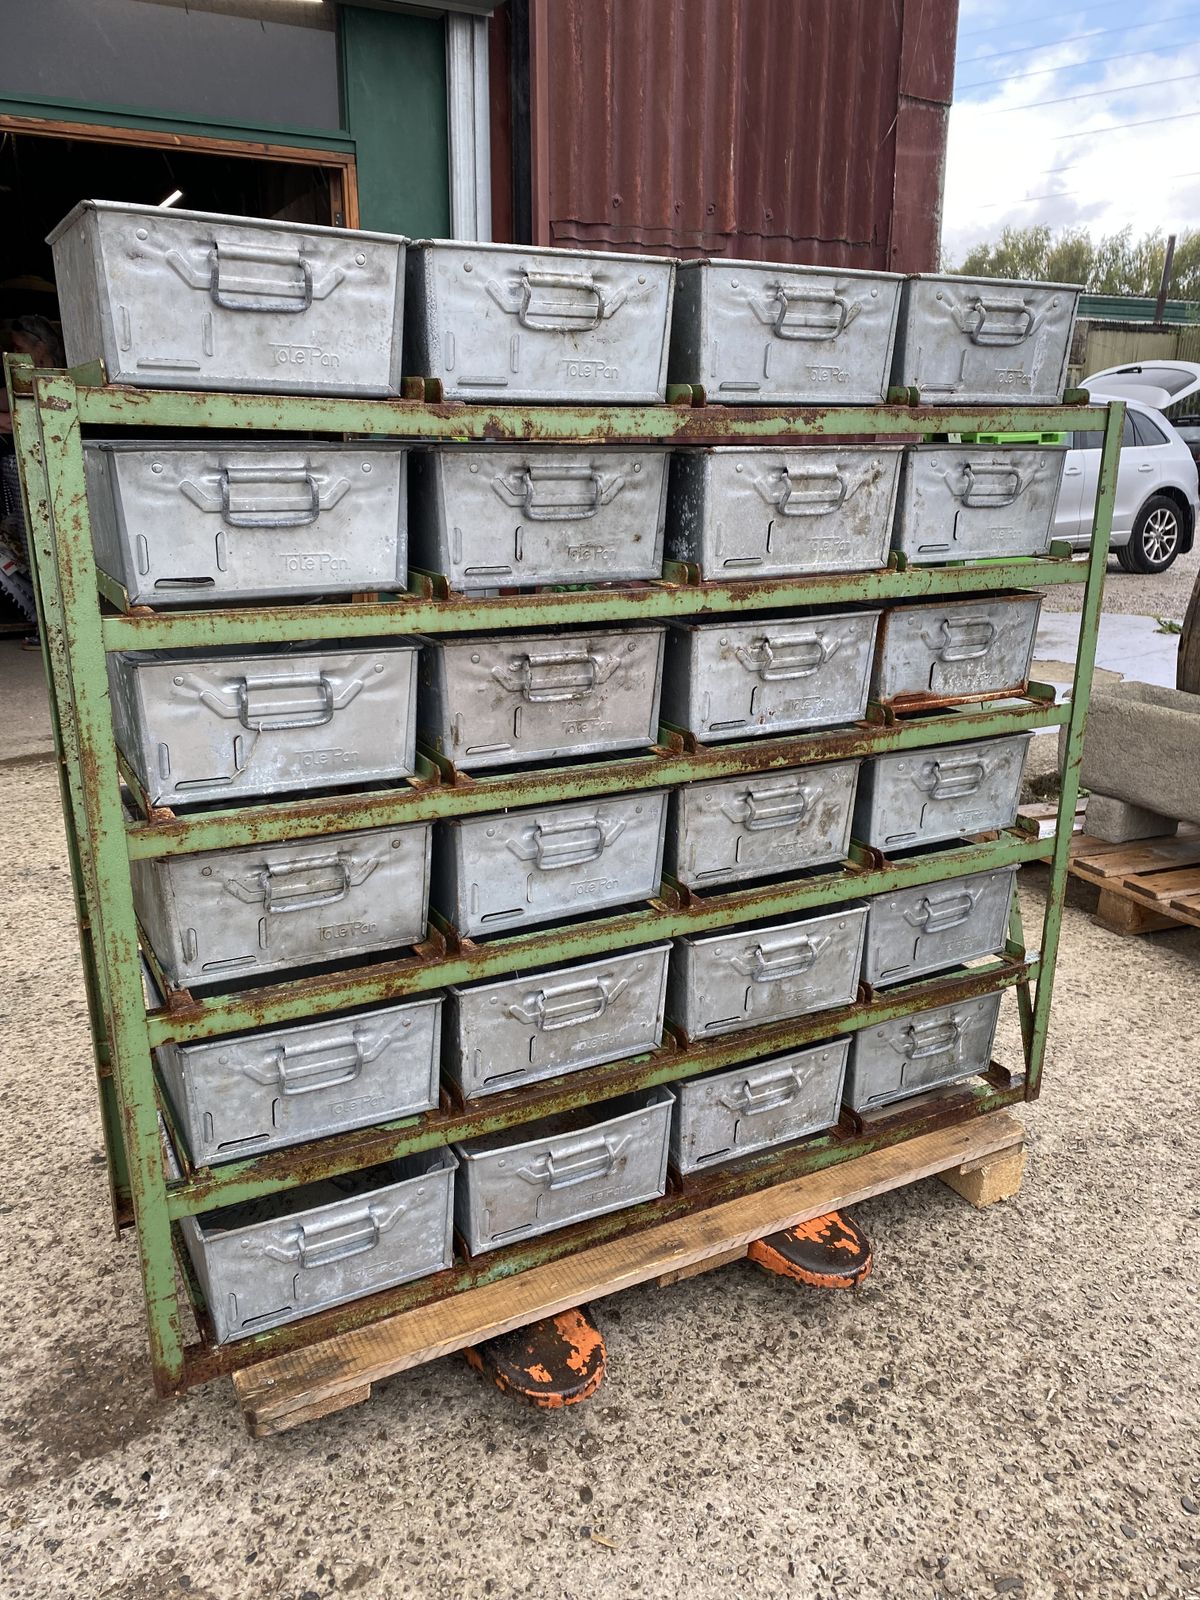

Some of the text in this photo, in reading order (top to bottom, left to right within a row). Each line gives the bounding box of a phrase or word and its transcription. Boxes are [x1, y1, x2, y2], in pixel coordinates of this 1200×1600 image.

[268, 342, 341, 368] Tote Pan
[562, 358, 619, 379] Tote Pan
[805, 364, 850, 383] Tote Pan
[280, 552, 349, 572] Tote Pan
[567, 544, 617, 562] Tote Pan
[562, 716, 615, 735] Tote Pan
[295, 747, 359, 767] Tote Pan
[571, 876, 619, 896] Tote Pan
[316, 919, 377, 941] Tote Pan
[328, 1094, 385, 1115] Tote Pan
